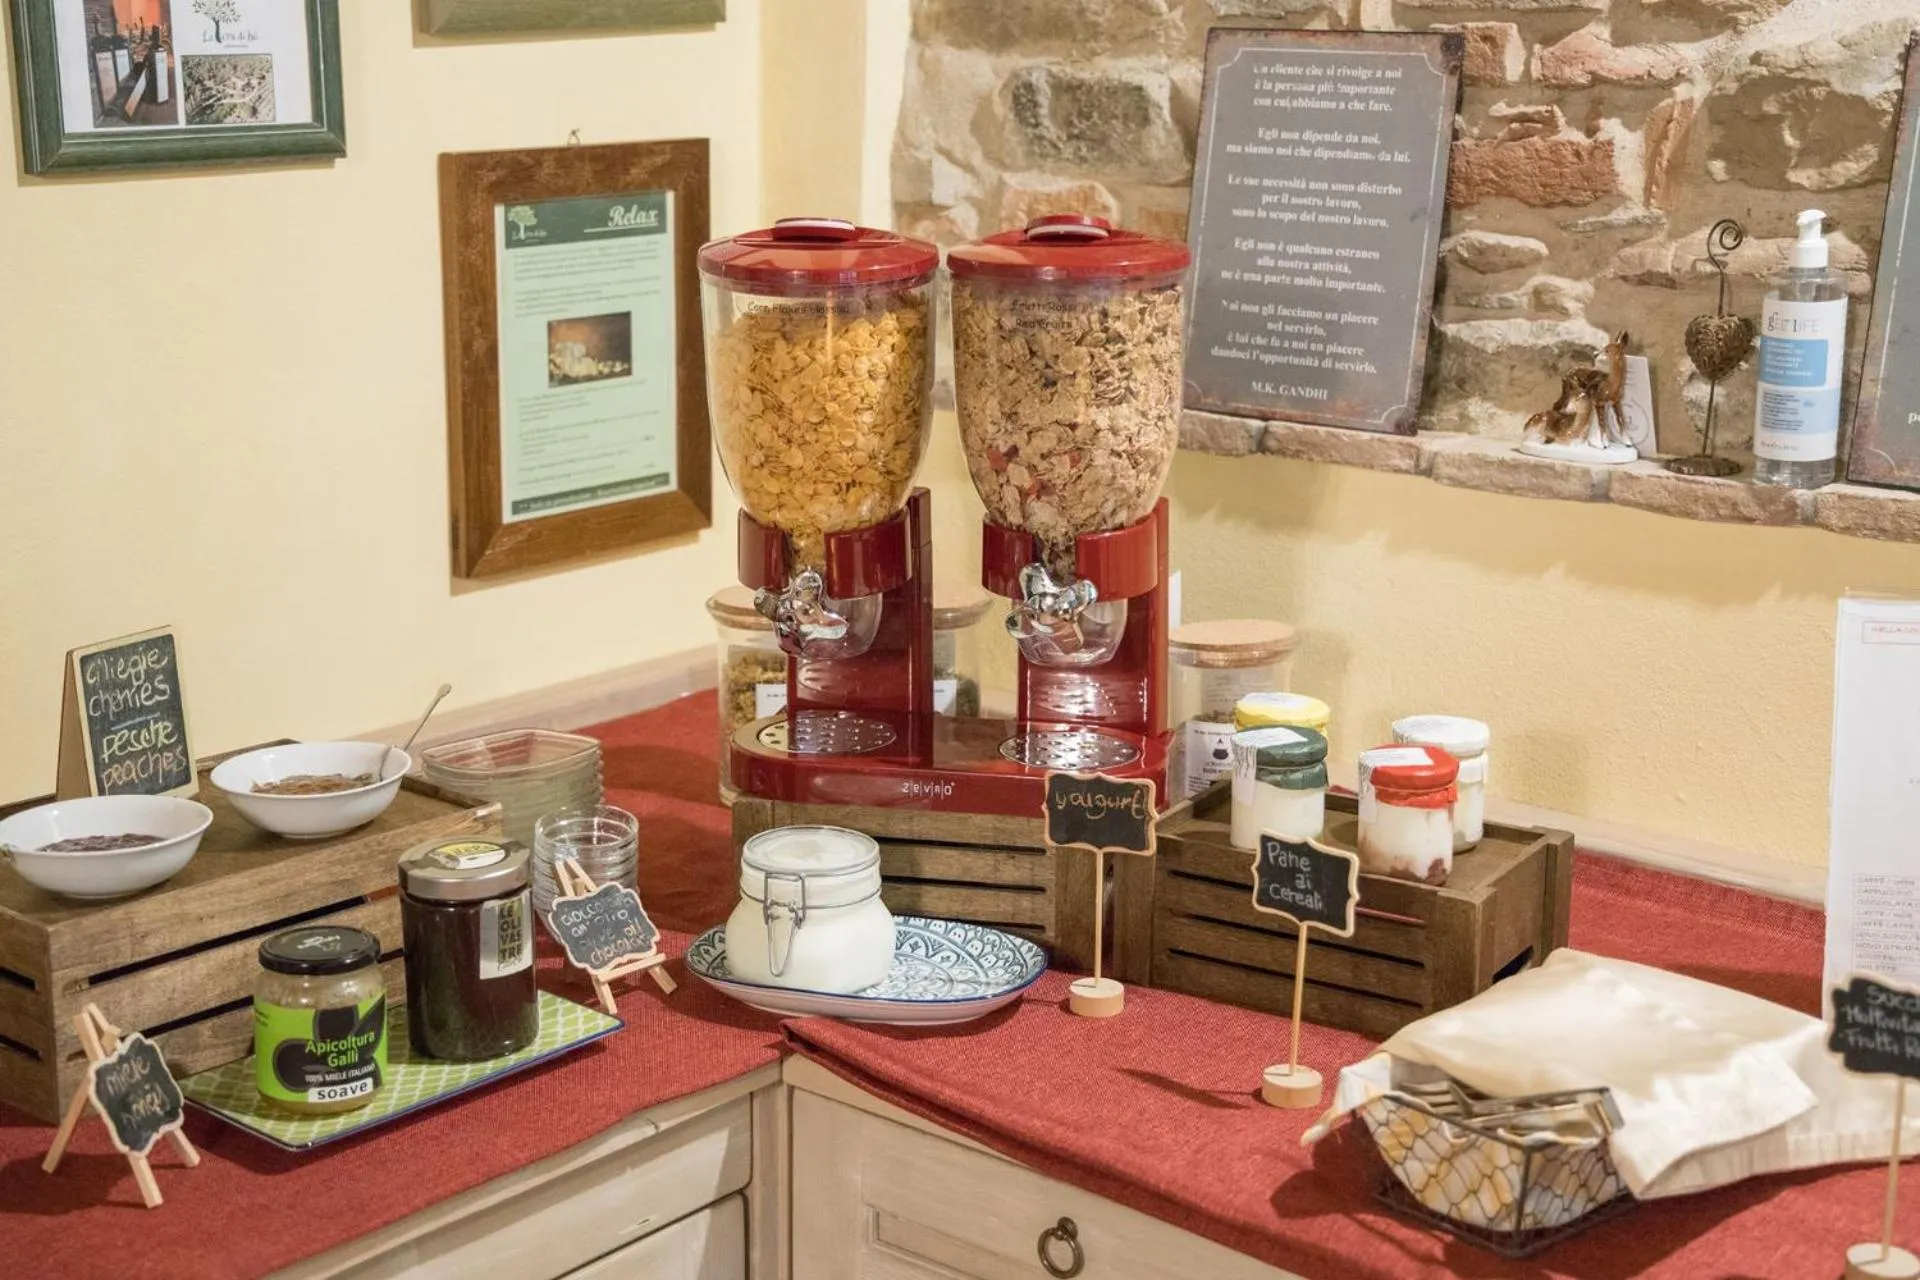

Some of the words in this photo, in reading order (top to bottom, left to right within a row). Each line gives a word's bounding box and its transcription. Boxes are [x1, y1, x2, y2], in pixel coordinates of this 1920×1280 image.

[1270, 63, 1304, 76] cliente
[1337, 65, 1374, 80] rivolge
[1375, 69, 1383, 78] a
[1385, 67, 1403, 79] noi
[1262, 79, 1273, 91] la
[1274, 81, 1316, 94] persona
[1253, 96, 1272, 107] con
[1291, 98, 1337, 110] abbiamo
[1338, 101, 1346, 110] a
[1347, 100, 1366, 111] che
[1257, 127, 1279, 141] Egli
[1280, 130, 1300, 140] non
[1302, 129, 1343, 144] dipende
[1345, 131, 1359, 143] da
[1226, 142, 1242, 153] ma
[1244, 143, 1274, 155] siamo
[1275, 144, 1292, 156] noi
[1294, 145, 1312, 158] che
[1377, 150, 1391, 162] da
[1228, 173, 1240, 185] Le
[1243, 175, 1260, 187] sue
[1308, 180, 1328, 191] non
[1331, 181, 1355, 193] sono
[1356, 180, 1403, 196] disturbo
[1261, 192, 1280, 206] per
[1281, 192, 1290, 204] il
[1290, 195, 1323, 207] nostro
[608, 204, 659, 229] Relax
[1232, 207, 1256, 218] sono
[1257, 207, 1267, 219] lo
[1268, 210, 1298, 223] scopo
[1299, 210, 1316, 223] del
[1317, 213, 1351, 225] nostro
[1234, 236, 1255, 251] Egli
[1256, 240, 1277, 251] non
[1286, 243, 1334, 257] qualcuno
[1335, 246, 1381, 260] estraneo
[1256, 255, 1275, 267] alla
[1277, 258, 1310, 270] nostra
[1220, 269, 1233, 280] ne
[1243, 271, 1262, 282] una
[1264, 273, 1292, 286] parte
[1293, 275, 1323, 288] molto
[1240, 303, 1260, 314] non
[1261, 303, 1275, 317] gli
[1276, 304, 1322, 319] facciamo
[1325, 311, 1338, 322] un
[1340, 311, 1380, 326] piacere
[1266, 321, 1283, 332] nel
[1235, 331, 1249, 344] lui
[1250, 334, 1269, 346] che
[1270, 335, 1281, 348] fa
[1282, 340, 1290, 348] a
[1291, 339, 1308, 351] noi
[1310, 342, 1324, 352] un
[1325, 342, 1365, 357] piacere
[1211, 345, 1250, 360] dandoci
[1321, 357, 1333, 369] di
[1278, 383, 1329, 401] GANDHI
[103, 744, 188, 797] peaches
[1266, 840, 1312, 872] Pane
[304, 1032, 375, 1056] Apicoltura
[327, 1048, 359, 1068] Galli
